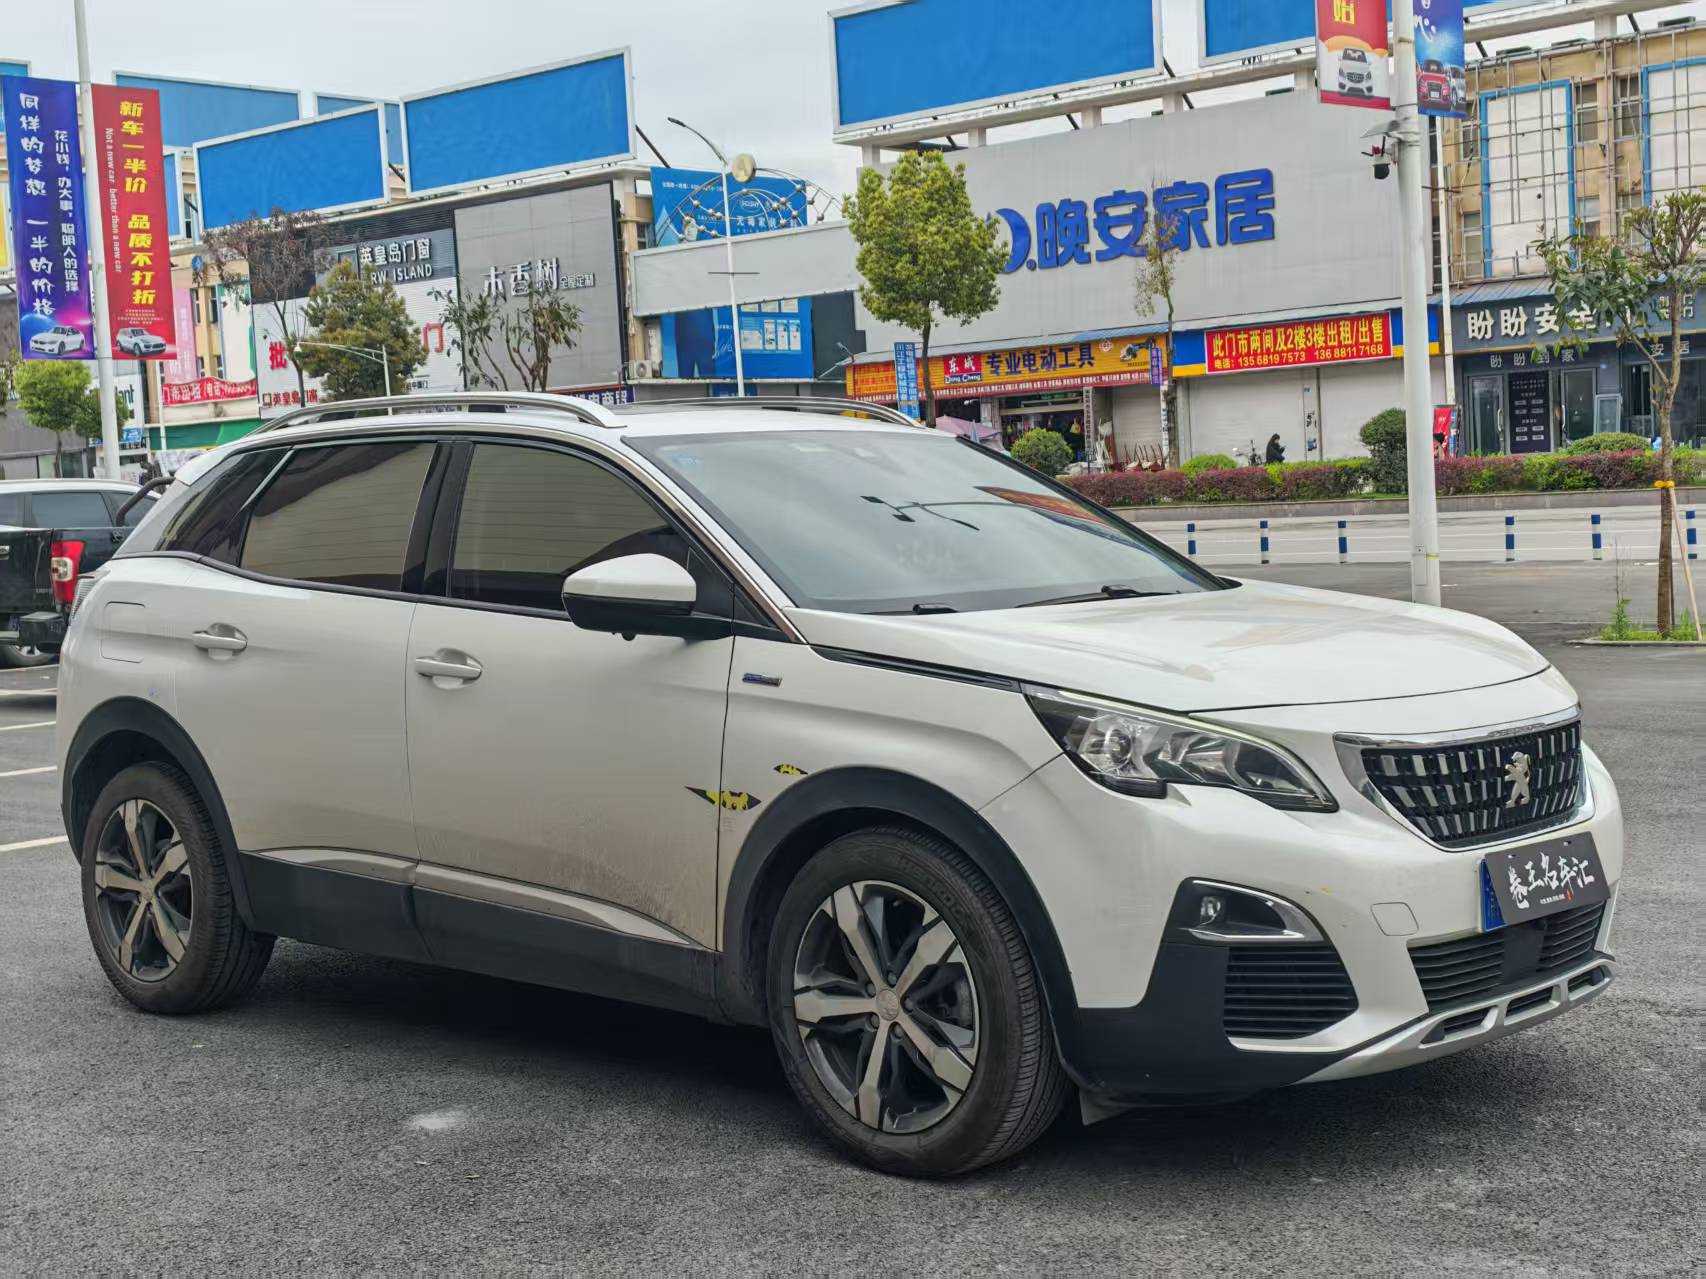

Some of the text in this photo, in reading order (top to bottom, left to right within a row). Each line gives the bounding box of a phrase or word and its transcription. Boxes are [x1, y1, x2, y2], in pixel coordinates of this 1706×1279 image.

[119, 100, 147, 193] 新车一半价
[19, 93, 56, 317] 同样的梦想 一半的价格
[1035, 168, 1275, 270] 晚安家居
[128, 214, 156, 305] 品质不打折
[359, 238, 431, 267] 英皇岛门窗
[392, 264, 433, 282] ISLAND
[986, 343, 1094, 376] 专业电动工具
